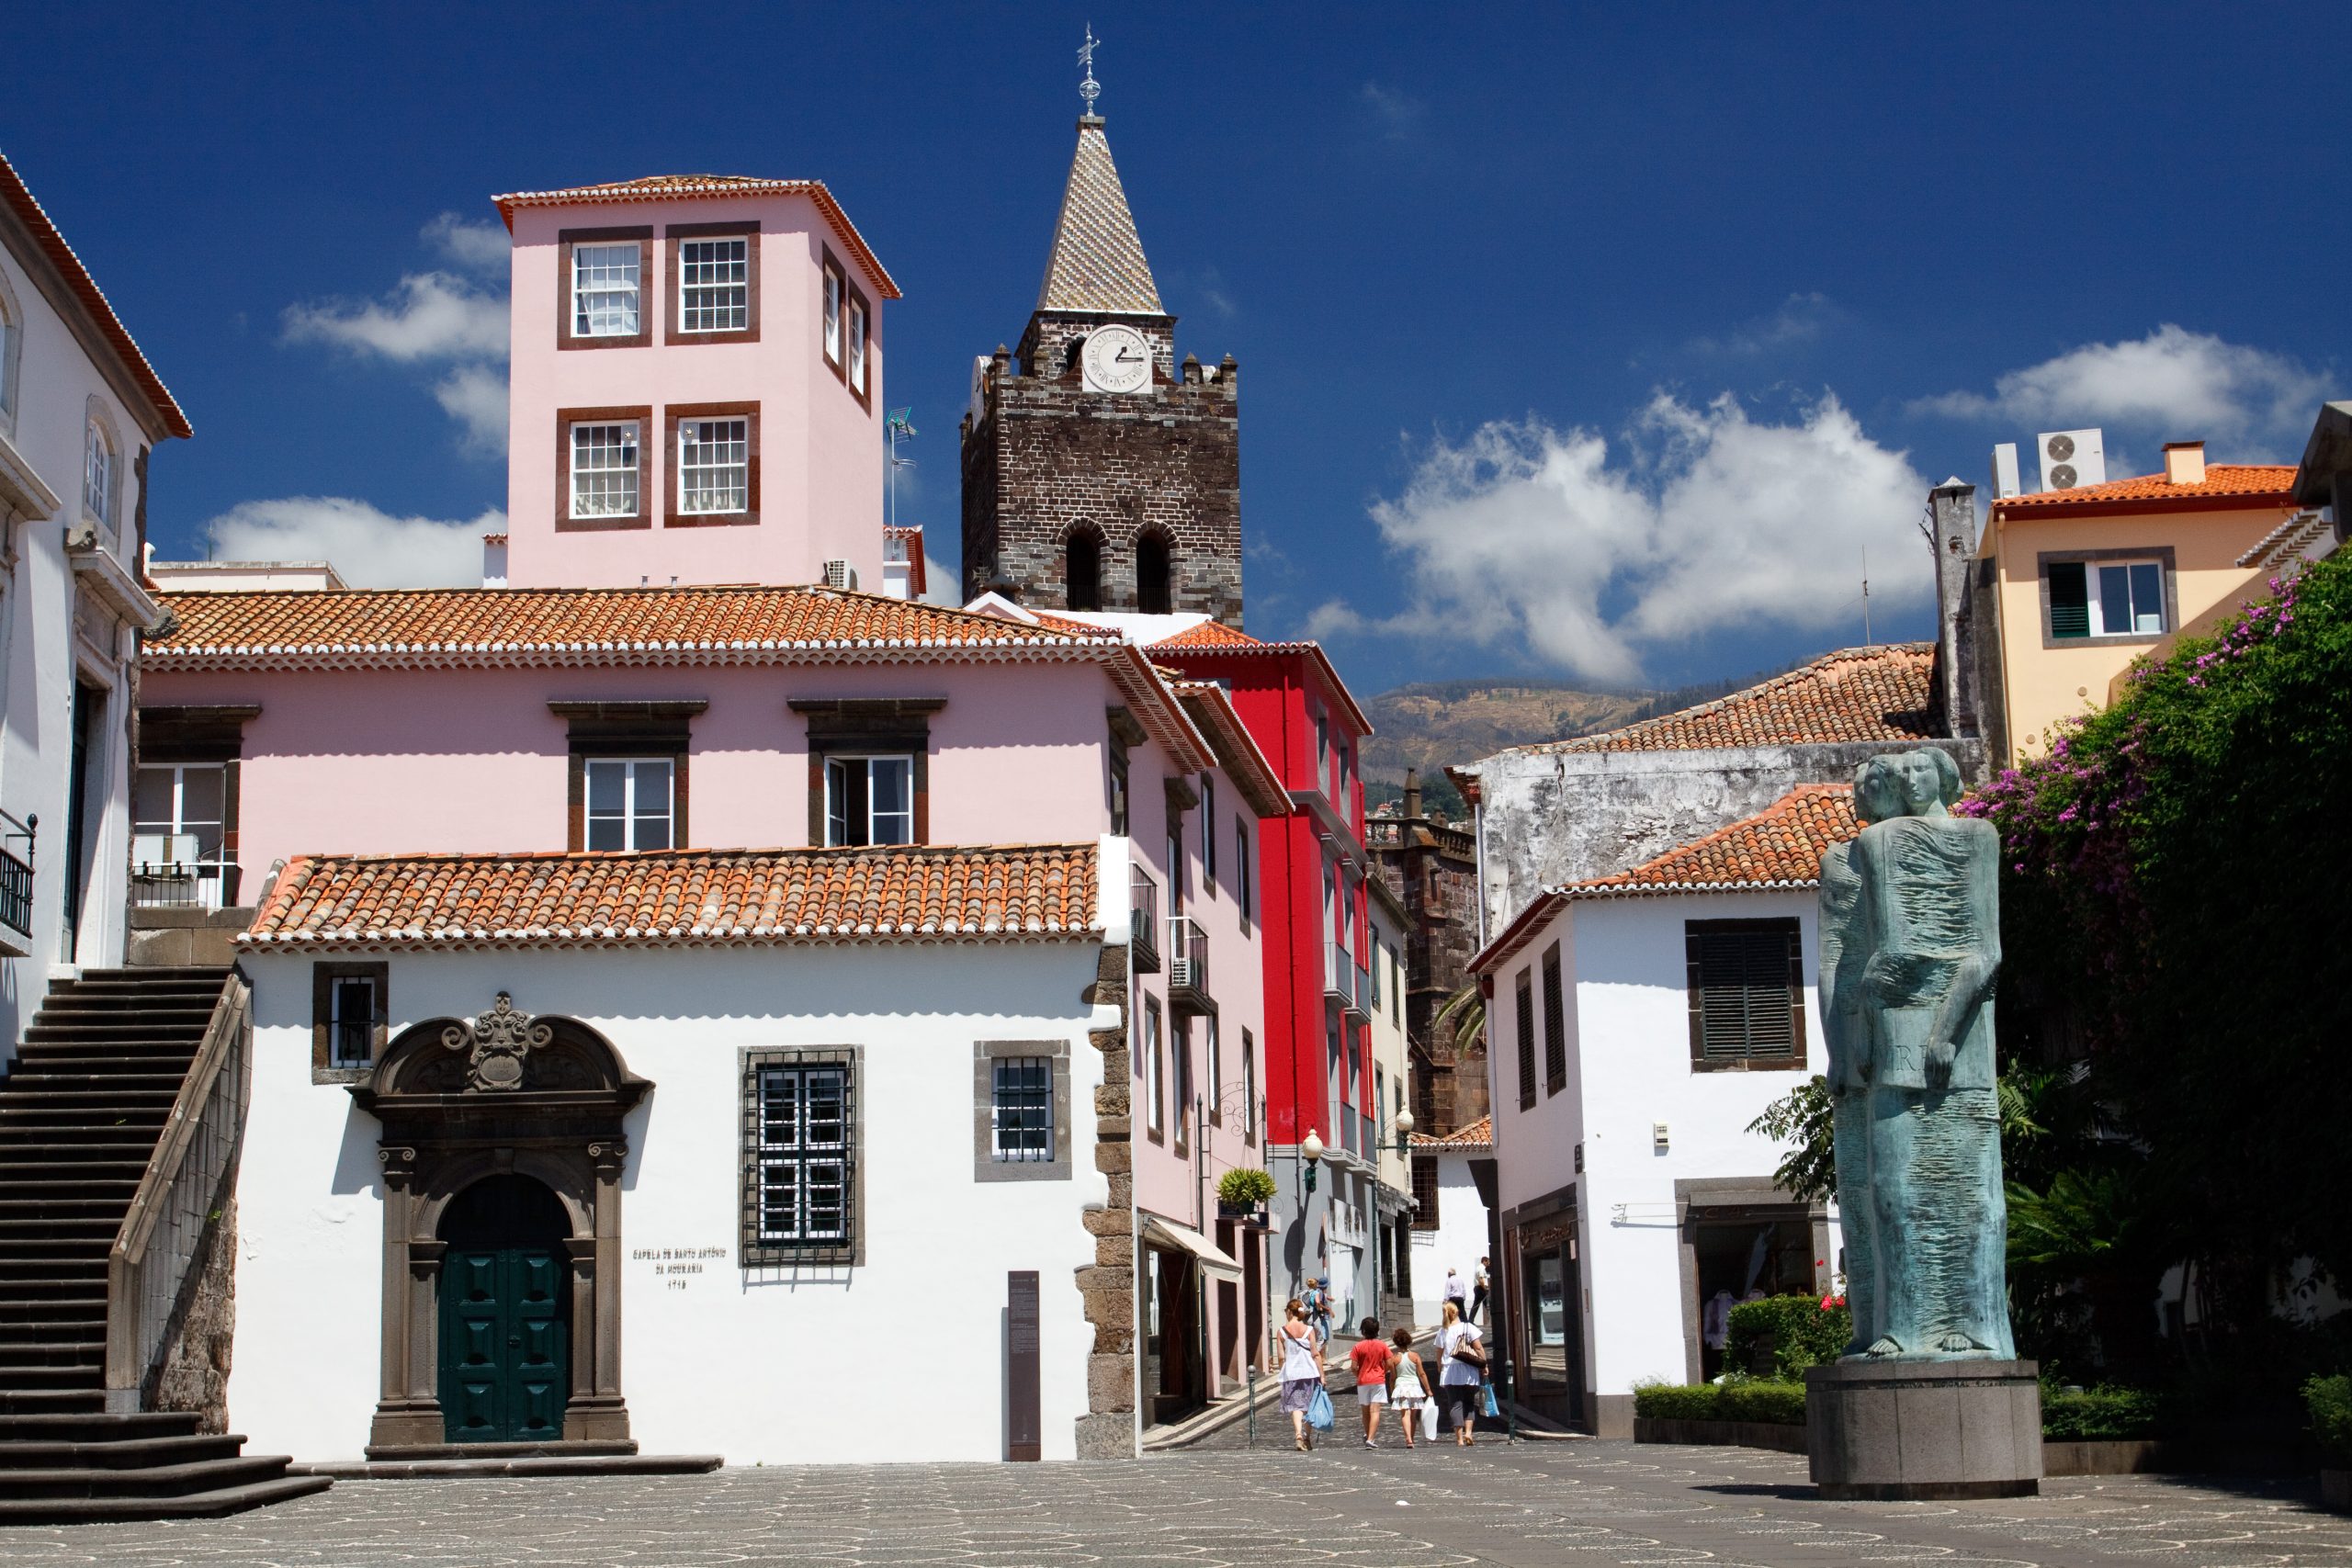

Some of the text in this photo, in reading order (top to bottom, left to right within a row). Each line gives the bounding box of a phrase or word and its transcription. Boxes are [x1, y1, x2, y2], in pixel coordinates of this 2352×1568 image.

[633, 1249, 661, 1259] CAPELA
[662, 1248, 671, 1259] DE
[674, 1248, 695, 1259] SANTO
[656, 1263, 703, 1274] DA MOURARIA
